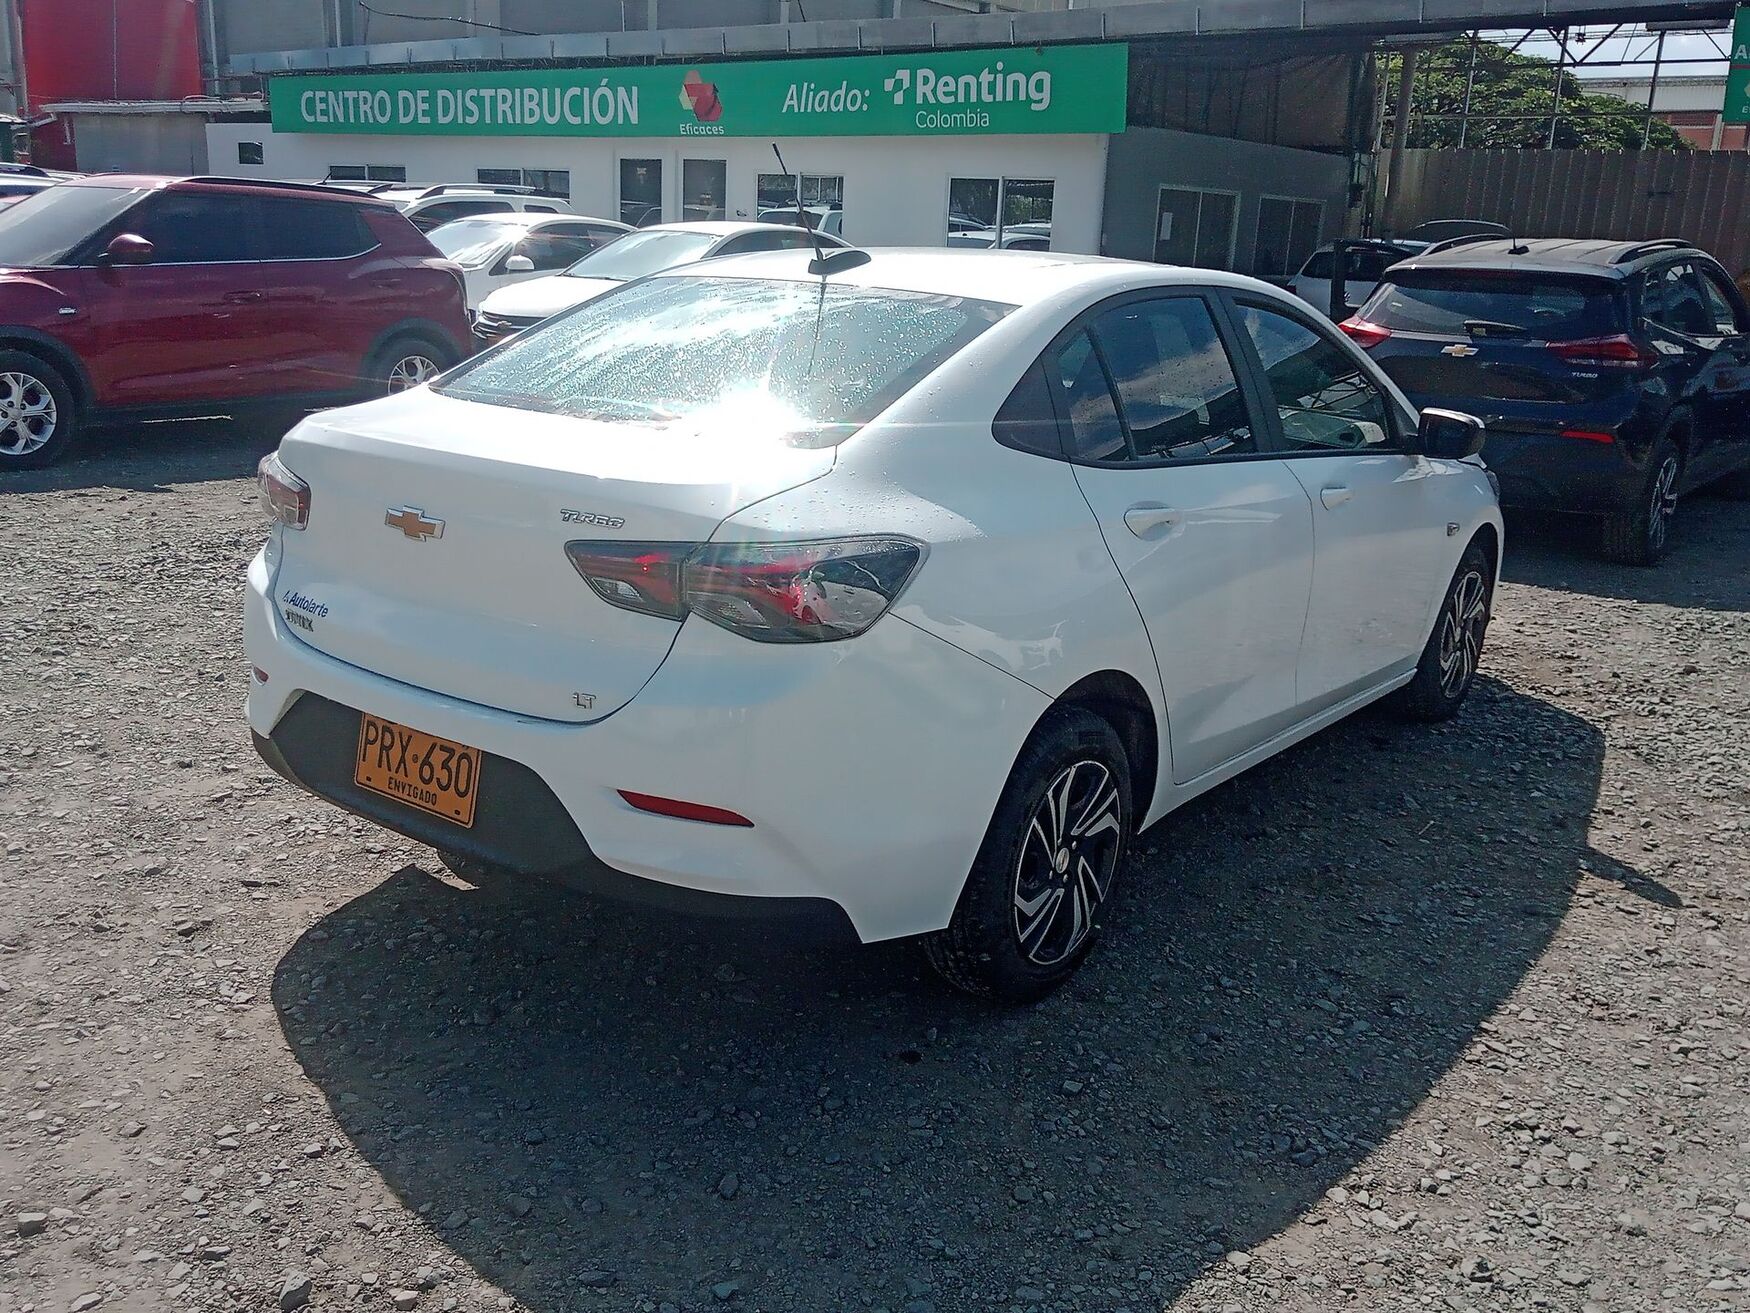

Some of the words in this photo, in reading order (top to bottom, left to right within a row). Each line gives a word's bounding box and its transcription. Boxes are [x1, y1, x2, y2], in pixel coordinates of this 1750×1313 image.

[782, 80, 870, 113] Aliado:
[914, 62, 1051, 110] Renting
[300, 90, 391, 124] CENTRO
[398, 90, 430, 124] DE
[437, 78, 639, 125] DISTRIBUCIÓN
[679, 123, 725, 135] Eficaces
[915, 108, 990, 128] Colombia
[572, 692, 597, 709] LT
[387, 776, 437, 806] ENVIGADO
